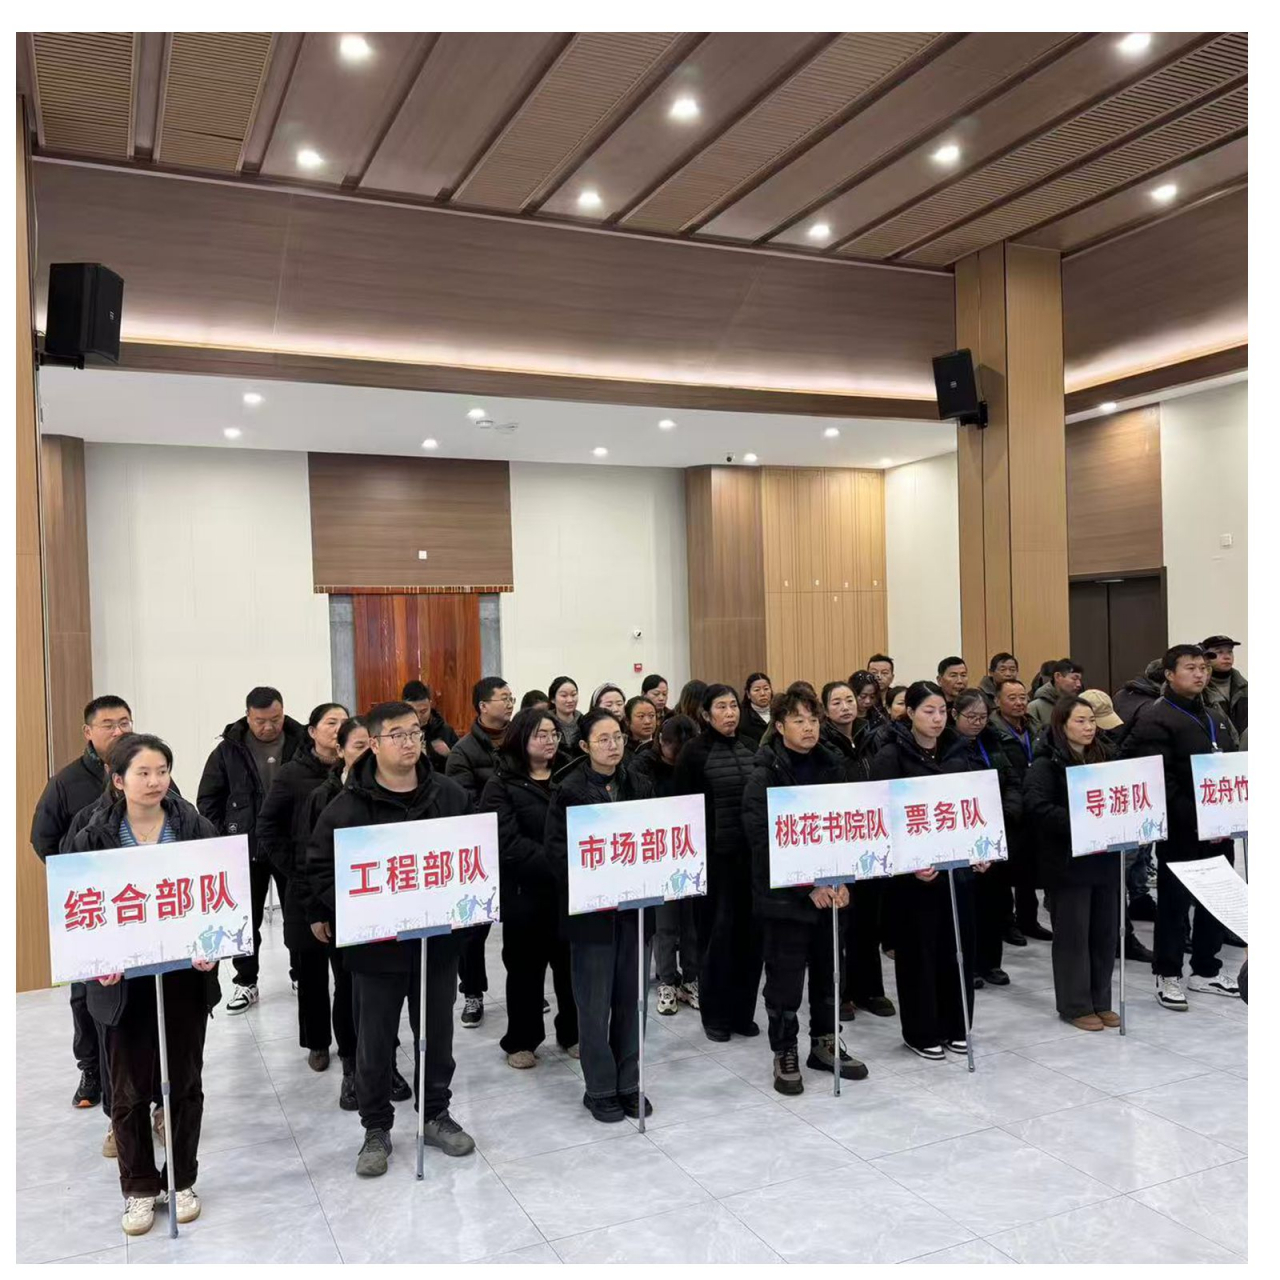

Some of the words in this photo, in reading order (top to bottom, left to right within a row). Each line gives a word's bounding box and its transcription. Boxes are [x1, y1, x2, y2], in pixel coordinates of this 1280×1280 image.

[904, 797, 988, 835] 票务队
[1086, 782, 1153, 818] 导游队
[578, 824, 697, 870] 市场部队
[775, 807, 889, 848] 桃花书院队
[348, 845, 489, 897] 工程部队
[63, 871, 238, 931] 综合部队
